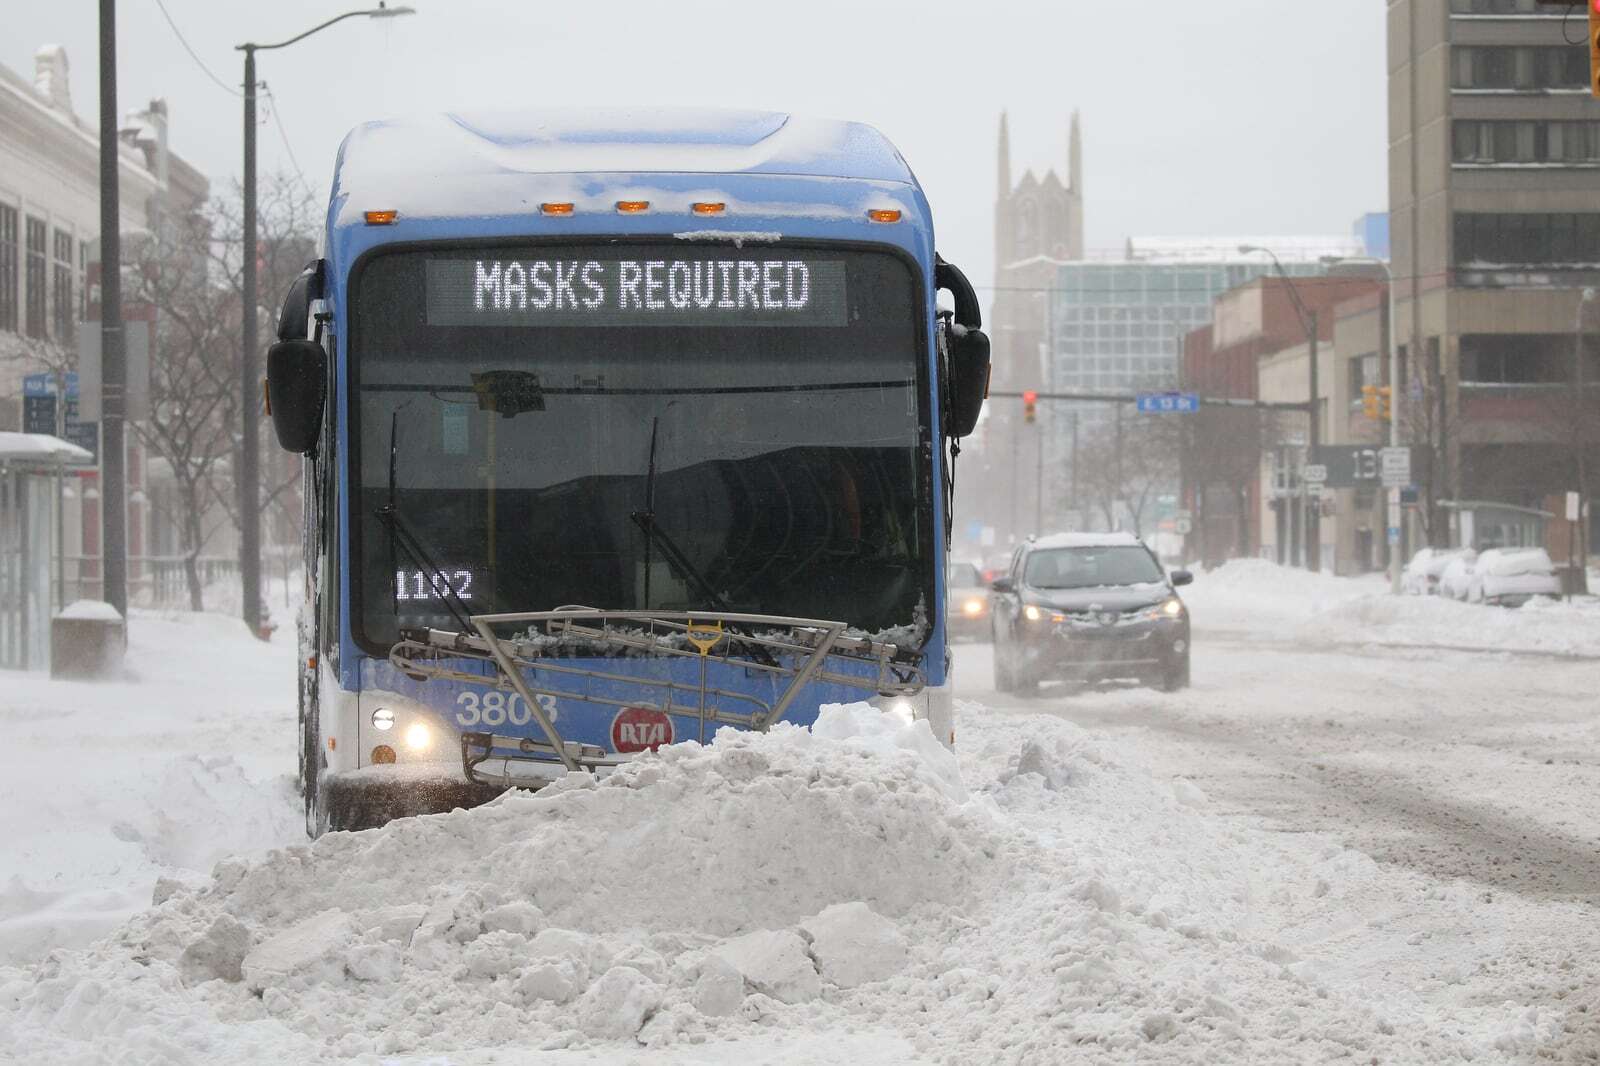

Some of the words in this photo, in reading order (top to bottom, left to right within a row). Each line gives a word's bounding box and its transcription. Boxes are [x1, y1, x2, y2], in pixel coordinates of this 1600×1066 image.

[474, 260, 604, 310] MASKS
[618, 260, 809, 310] REQUIRED
[1352, 449, 1384, 479] 13
[620, 722, 666, 745] RTA
